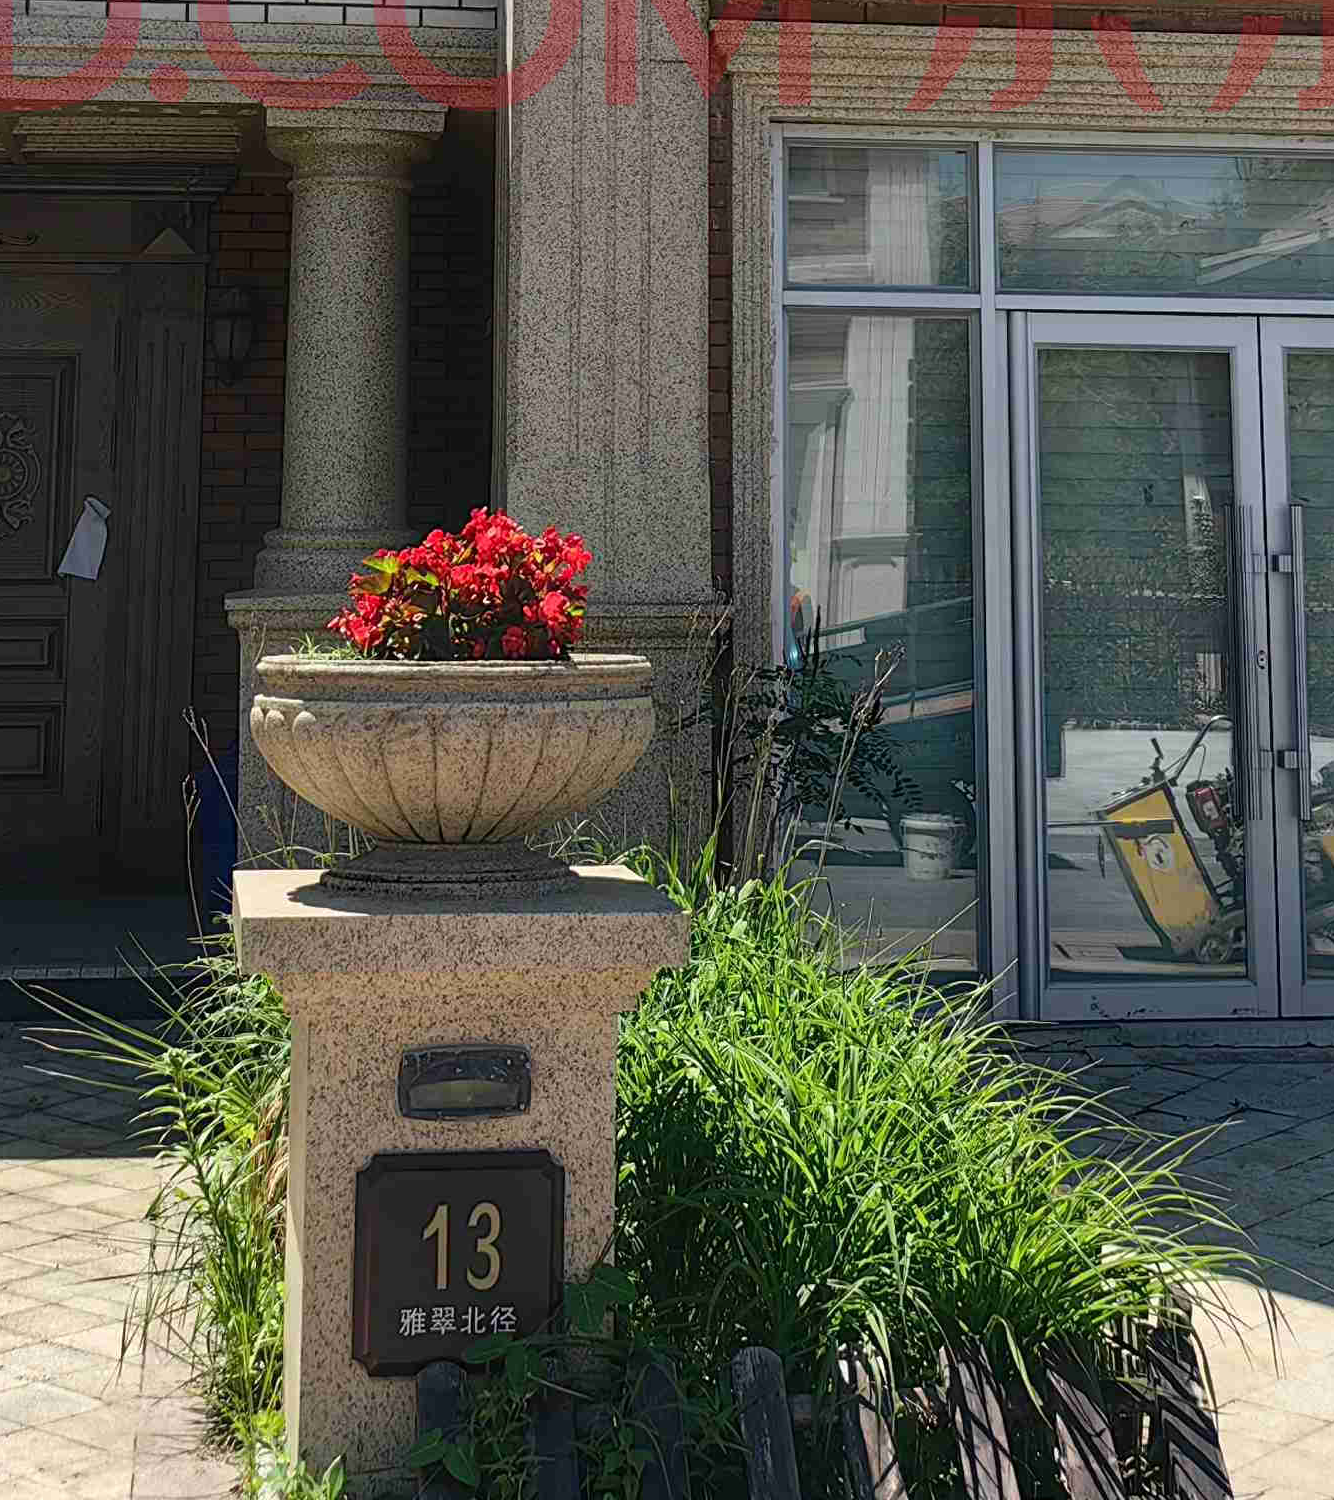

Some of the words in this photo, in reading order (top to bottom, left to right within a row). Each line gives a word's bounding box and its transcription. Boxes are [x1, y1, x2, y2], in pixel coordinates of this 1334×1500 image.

[421, 1201, 502, 1291] 13
[398, 1305, 518, 1337] 雅翠北径
